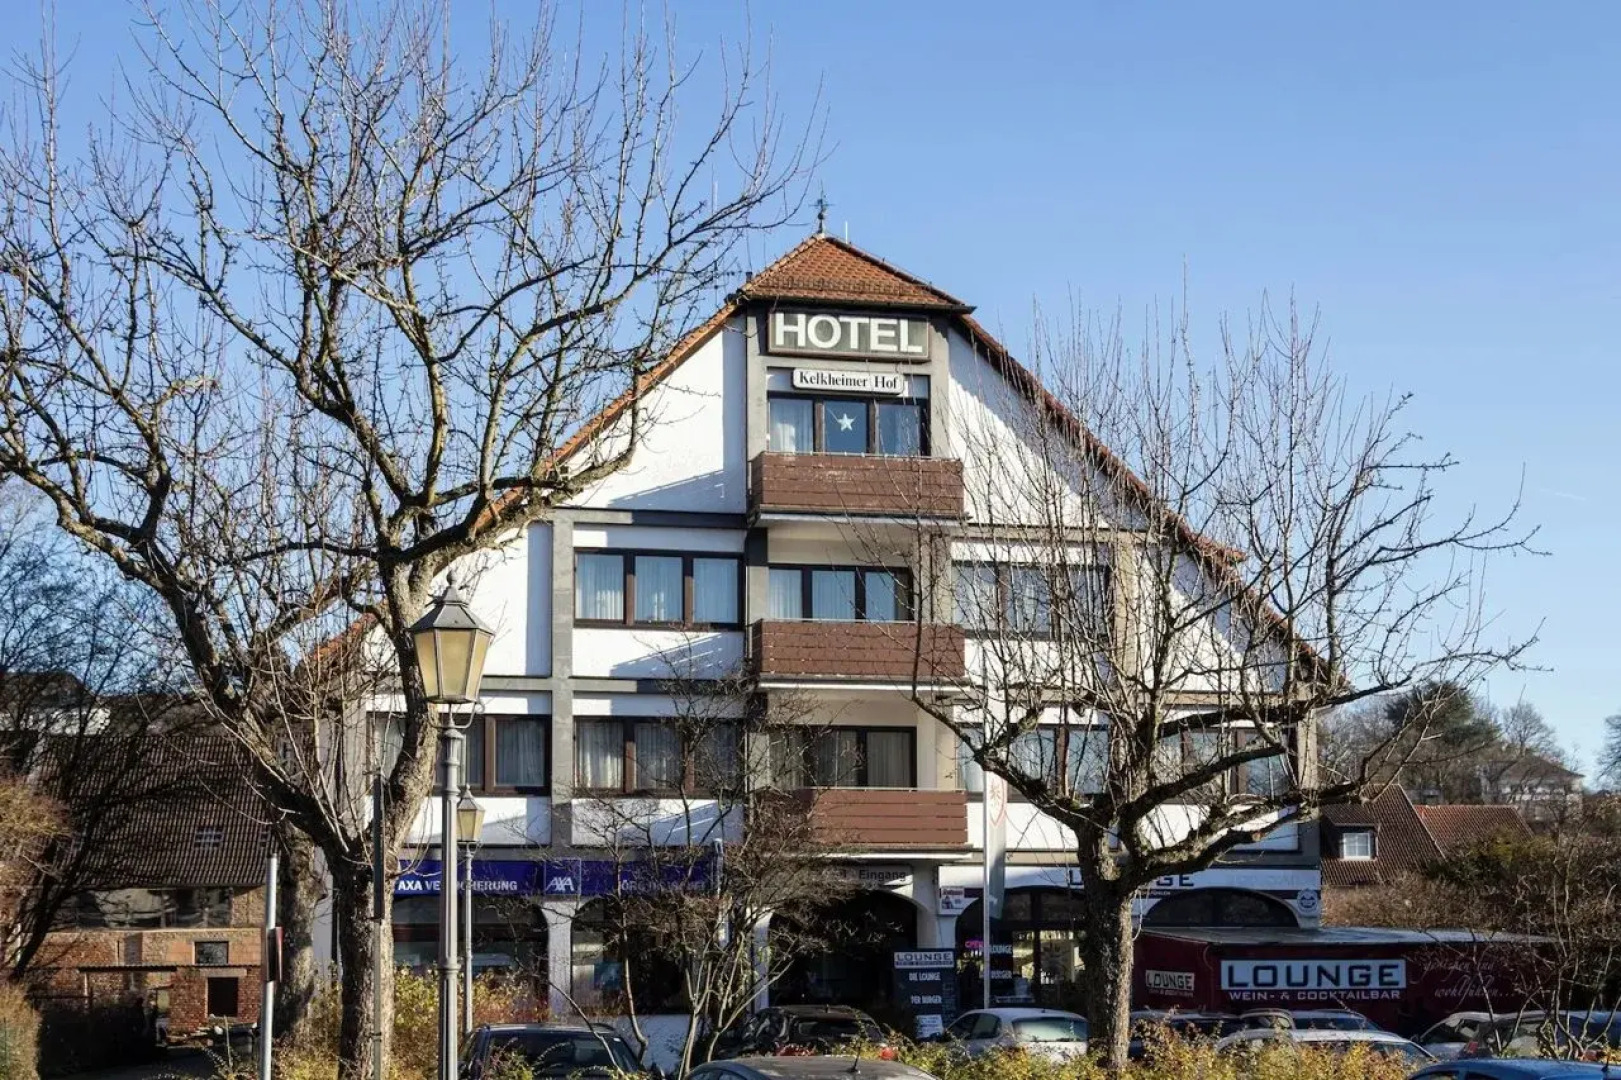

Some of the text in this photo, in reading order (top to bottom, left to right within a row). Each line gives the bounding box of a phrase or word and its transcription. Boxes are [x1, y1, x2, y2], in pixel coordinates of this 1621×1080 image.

[774, 312, 923, 353] HOTEL
[798, 371, 899, 390] Kelkheimer Hof
[545, 876, 575, 892] AXA
[859, 869, 907, 882] Eingang
[1069, 869, 1194, 888] LGE
[397, 880, 423, 891] AXA
[896, 952, 952, 961] LOUNGE
[1146, 972, 1193, 990] LOUNGE
[1227, 965, 1400, 987] LOUNGE
[1229, 990, 1401, 1001] WEIN- & COCKTAILBAR
